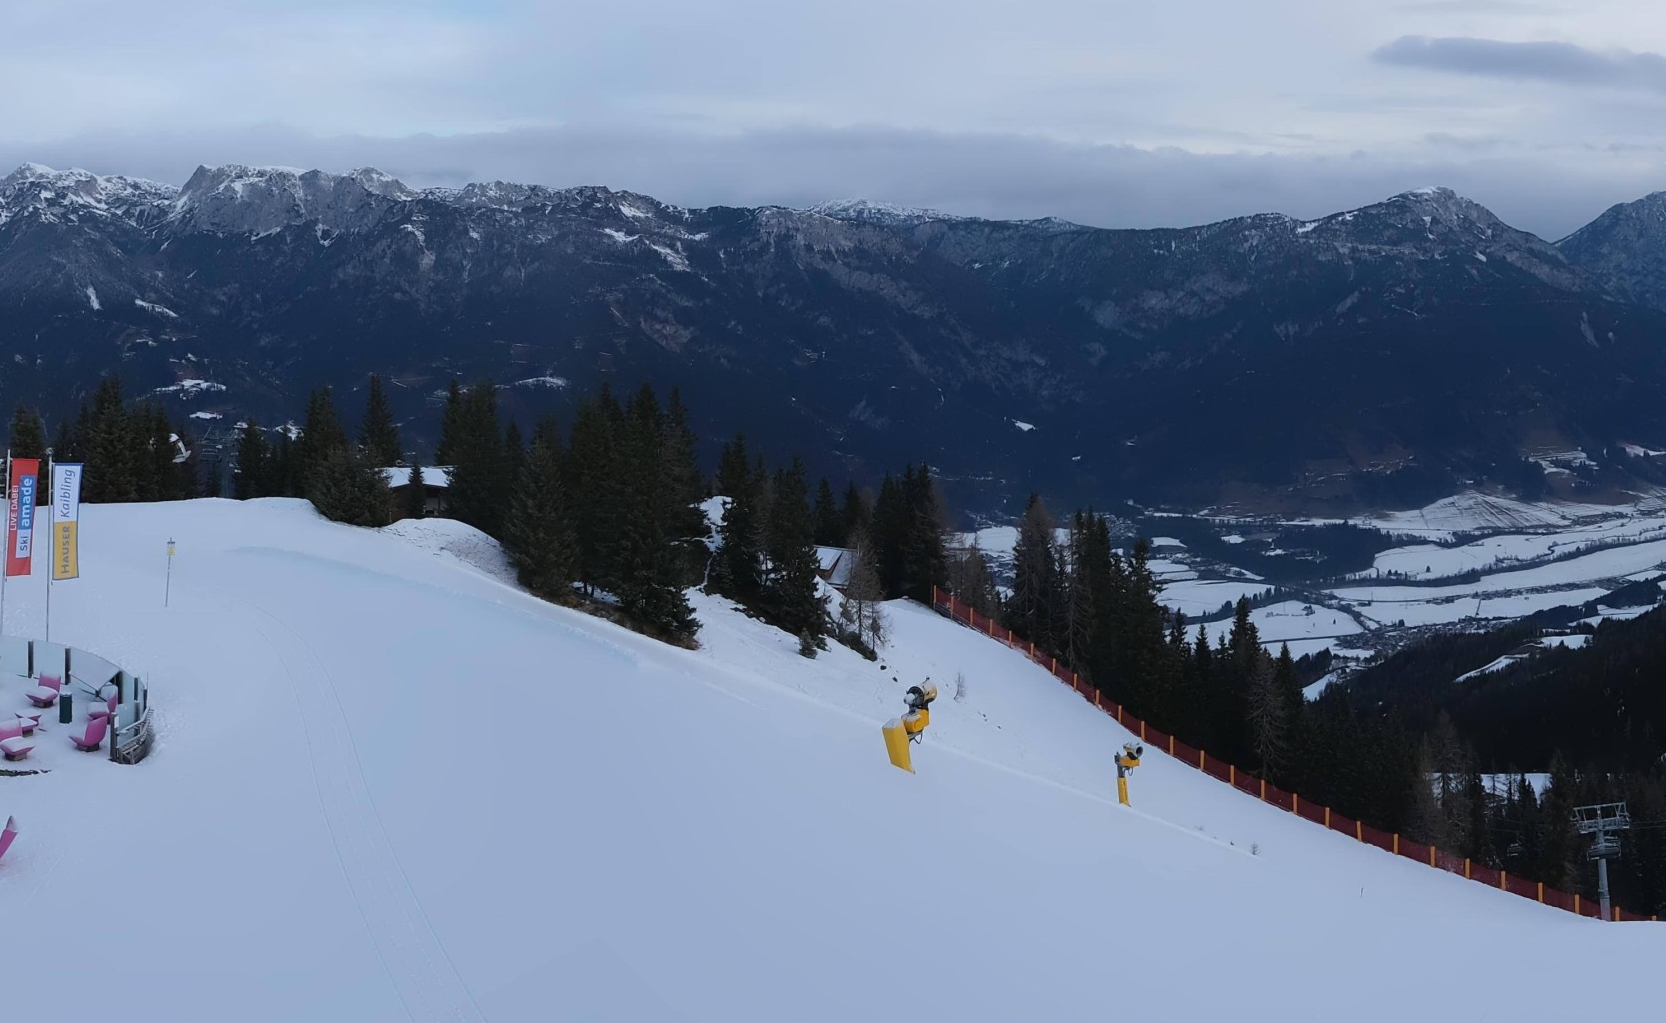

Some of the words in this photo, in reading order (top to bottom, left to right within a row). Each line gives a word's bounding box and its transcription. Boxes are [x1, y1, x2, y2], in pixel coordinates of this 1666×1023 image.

[11, 485, 19, 511] DABEI
[61, 469, 76, 518] Kaibling
[10, 512, 18, 531] LIVE
[20, 536, 28, 551] Ski
[61, 526, 70, 574] HAUSER
